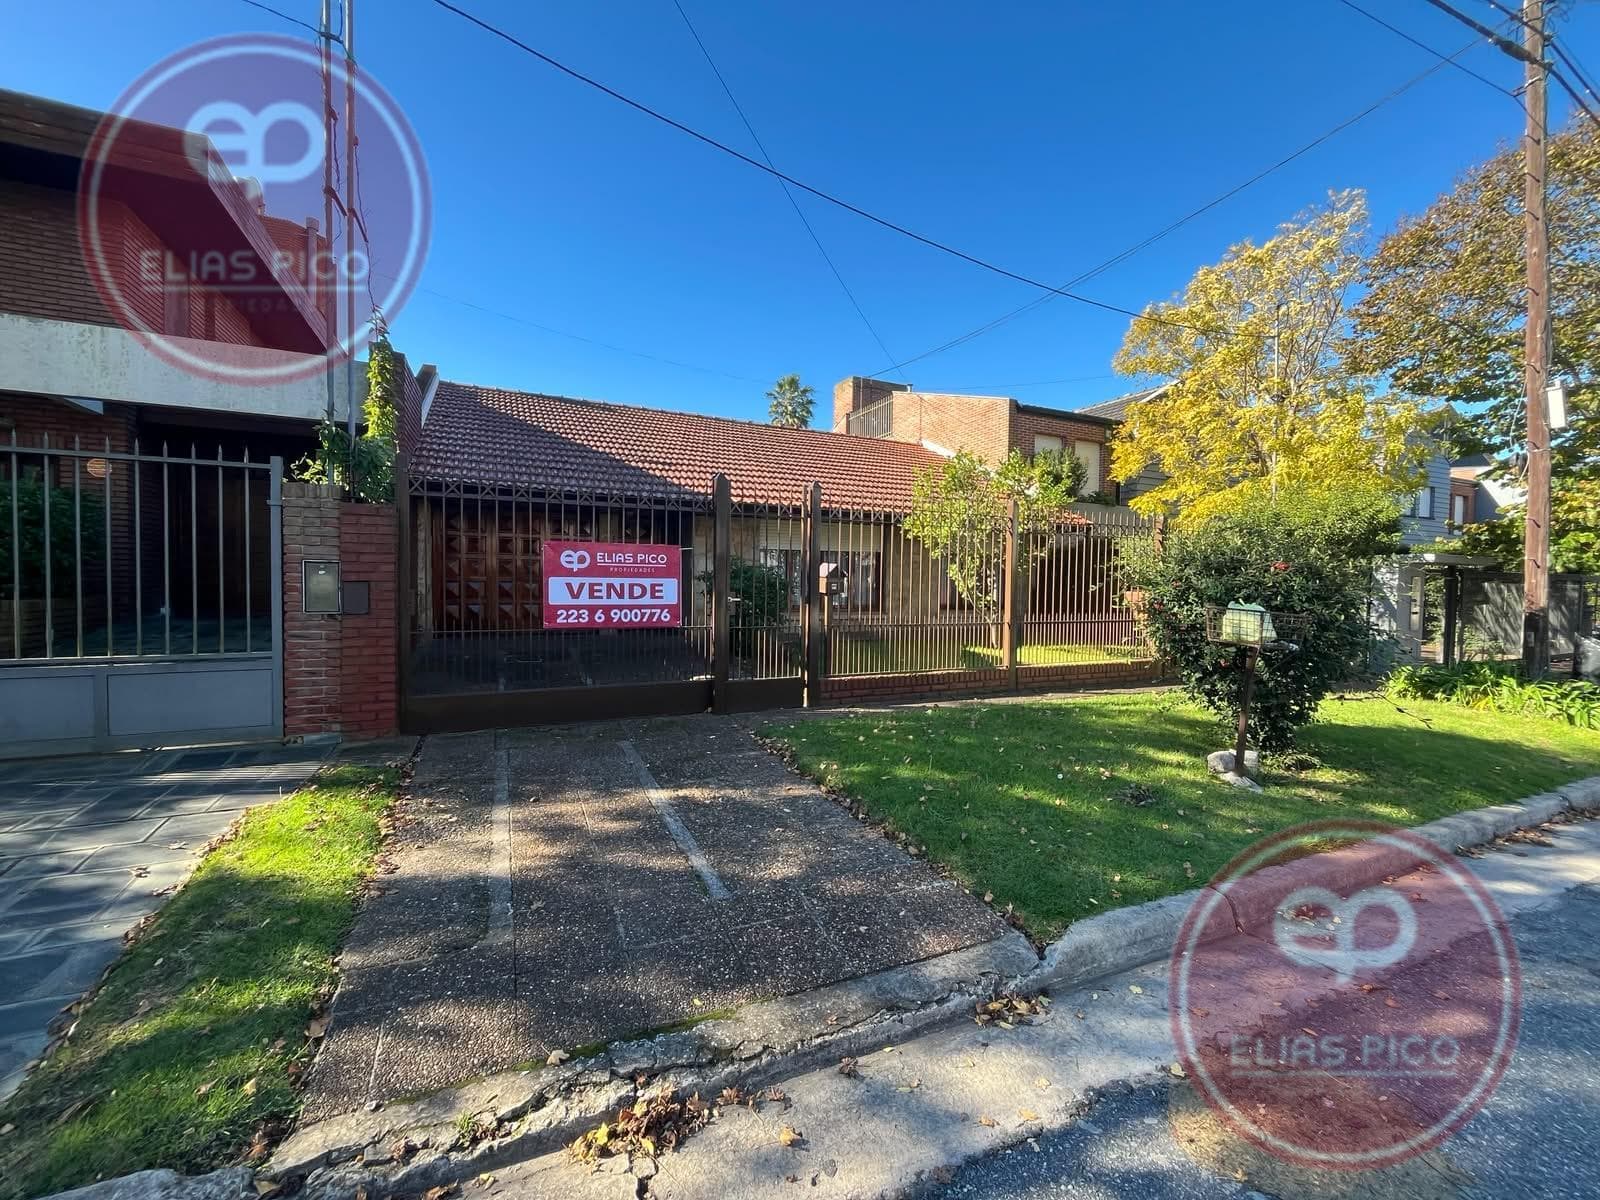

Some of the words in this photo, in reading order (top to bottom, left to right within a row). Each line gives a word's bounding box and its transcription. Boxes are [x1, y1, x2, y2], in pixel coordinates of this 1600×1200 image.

[596, 552, 634, 564] ELIAS
[637, 553, 668, 565] PICO
[564, 582, 664, 600] VENDE
[556, 609, 589, 624] 223
[594, 609, 605, 623] 6
[610, 608, 671, 623] 900776
